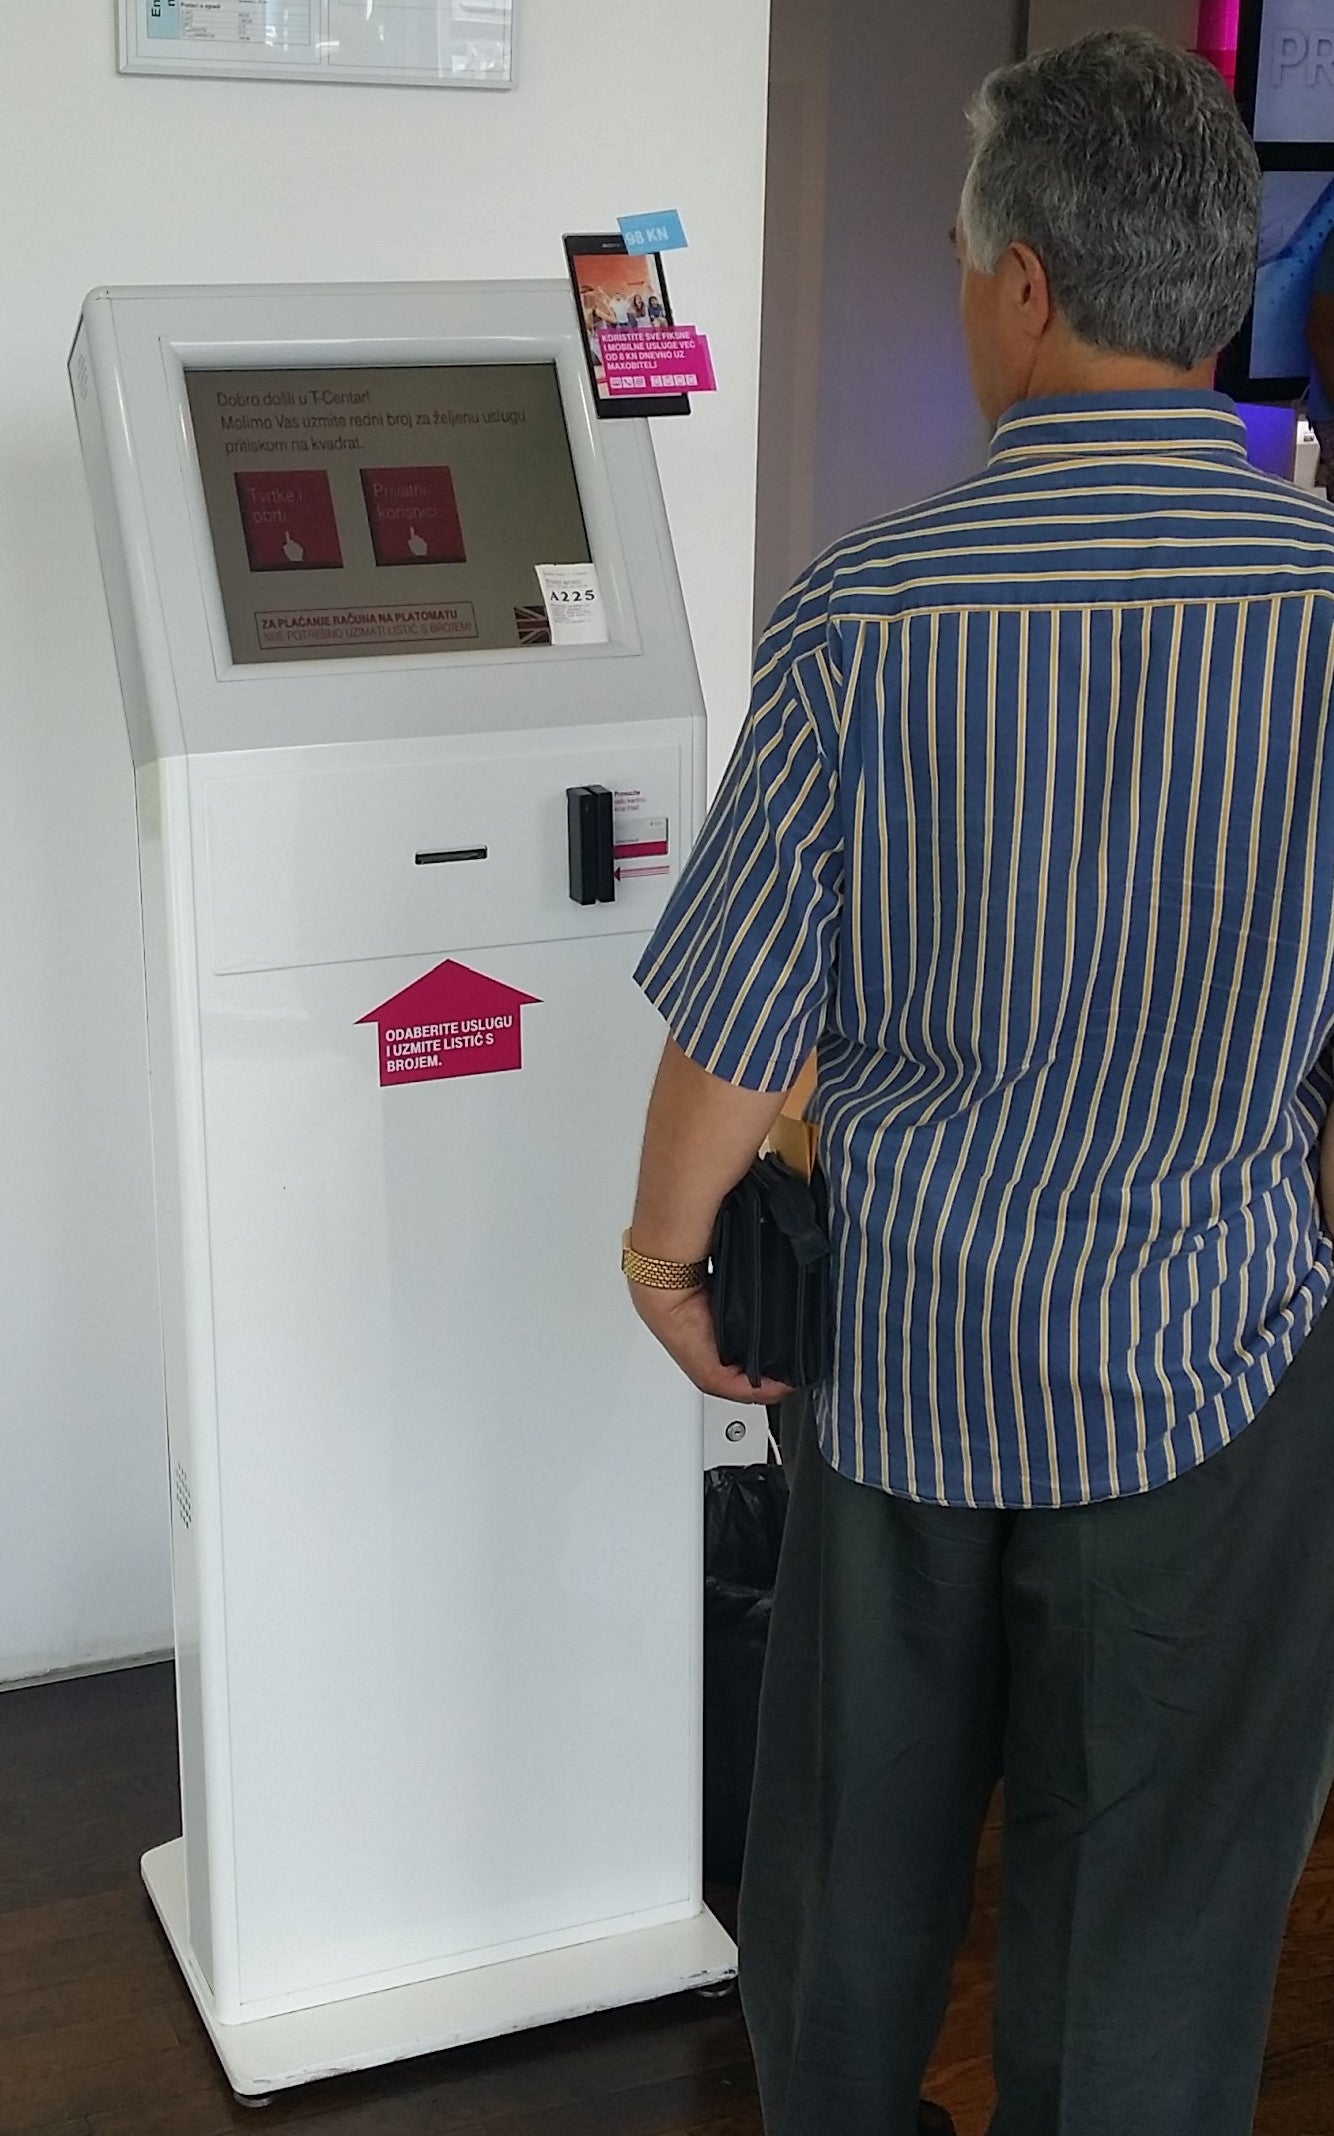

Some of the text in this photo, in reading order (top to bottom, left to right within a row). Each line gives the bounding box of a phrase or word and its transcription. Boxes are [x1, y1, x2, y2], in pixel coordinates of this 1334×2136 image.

[648, 227, 669, 242] KN
[645, 332, 661, 340] SVE
[662, 331, 690, 340] FIKSNE
[608, 342, 644, 351] MOBILNE
[646, 341, 678, 350] USLUGE
[606, 353, 618, 361] OD
[626, 352, 638, 360] KN
[638, 351, 672, 360] DNEVNO
[673, 350, 685, 358] UZ
[217, 392, 260, 406] Dobro
[298, 395, 306, 406] u
[221, 409, 526, 430] Molimo Vas uzmite redni broj za željenu uslugu
[225, 437, 288, 455] pritiskom
[291, 440, 308, 451] na
[550, 589, 596, 602] A225
[262, 619, 276, 630] ZA
[278, 616, 330, 628] PLAĆANJE
[378, 614, 394, 623] NA
[395, 610, 458, 622] PLATOMATU
[287, 628, 344, 641] POTREBNO
[385, 1016, 513, 1042] ODABERITE USLUGU
[386, 1032, 494, 1058] I UZMITE LISTIĆ S
[386, 1055, 443, 1073] BROJEM.
